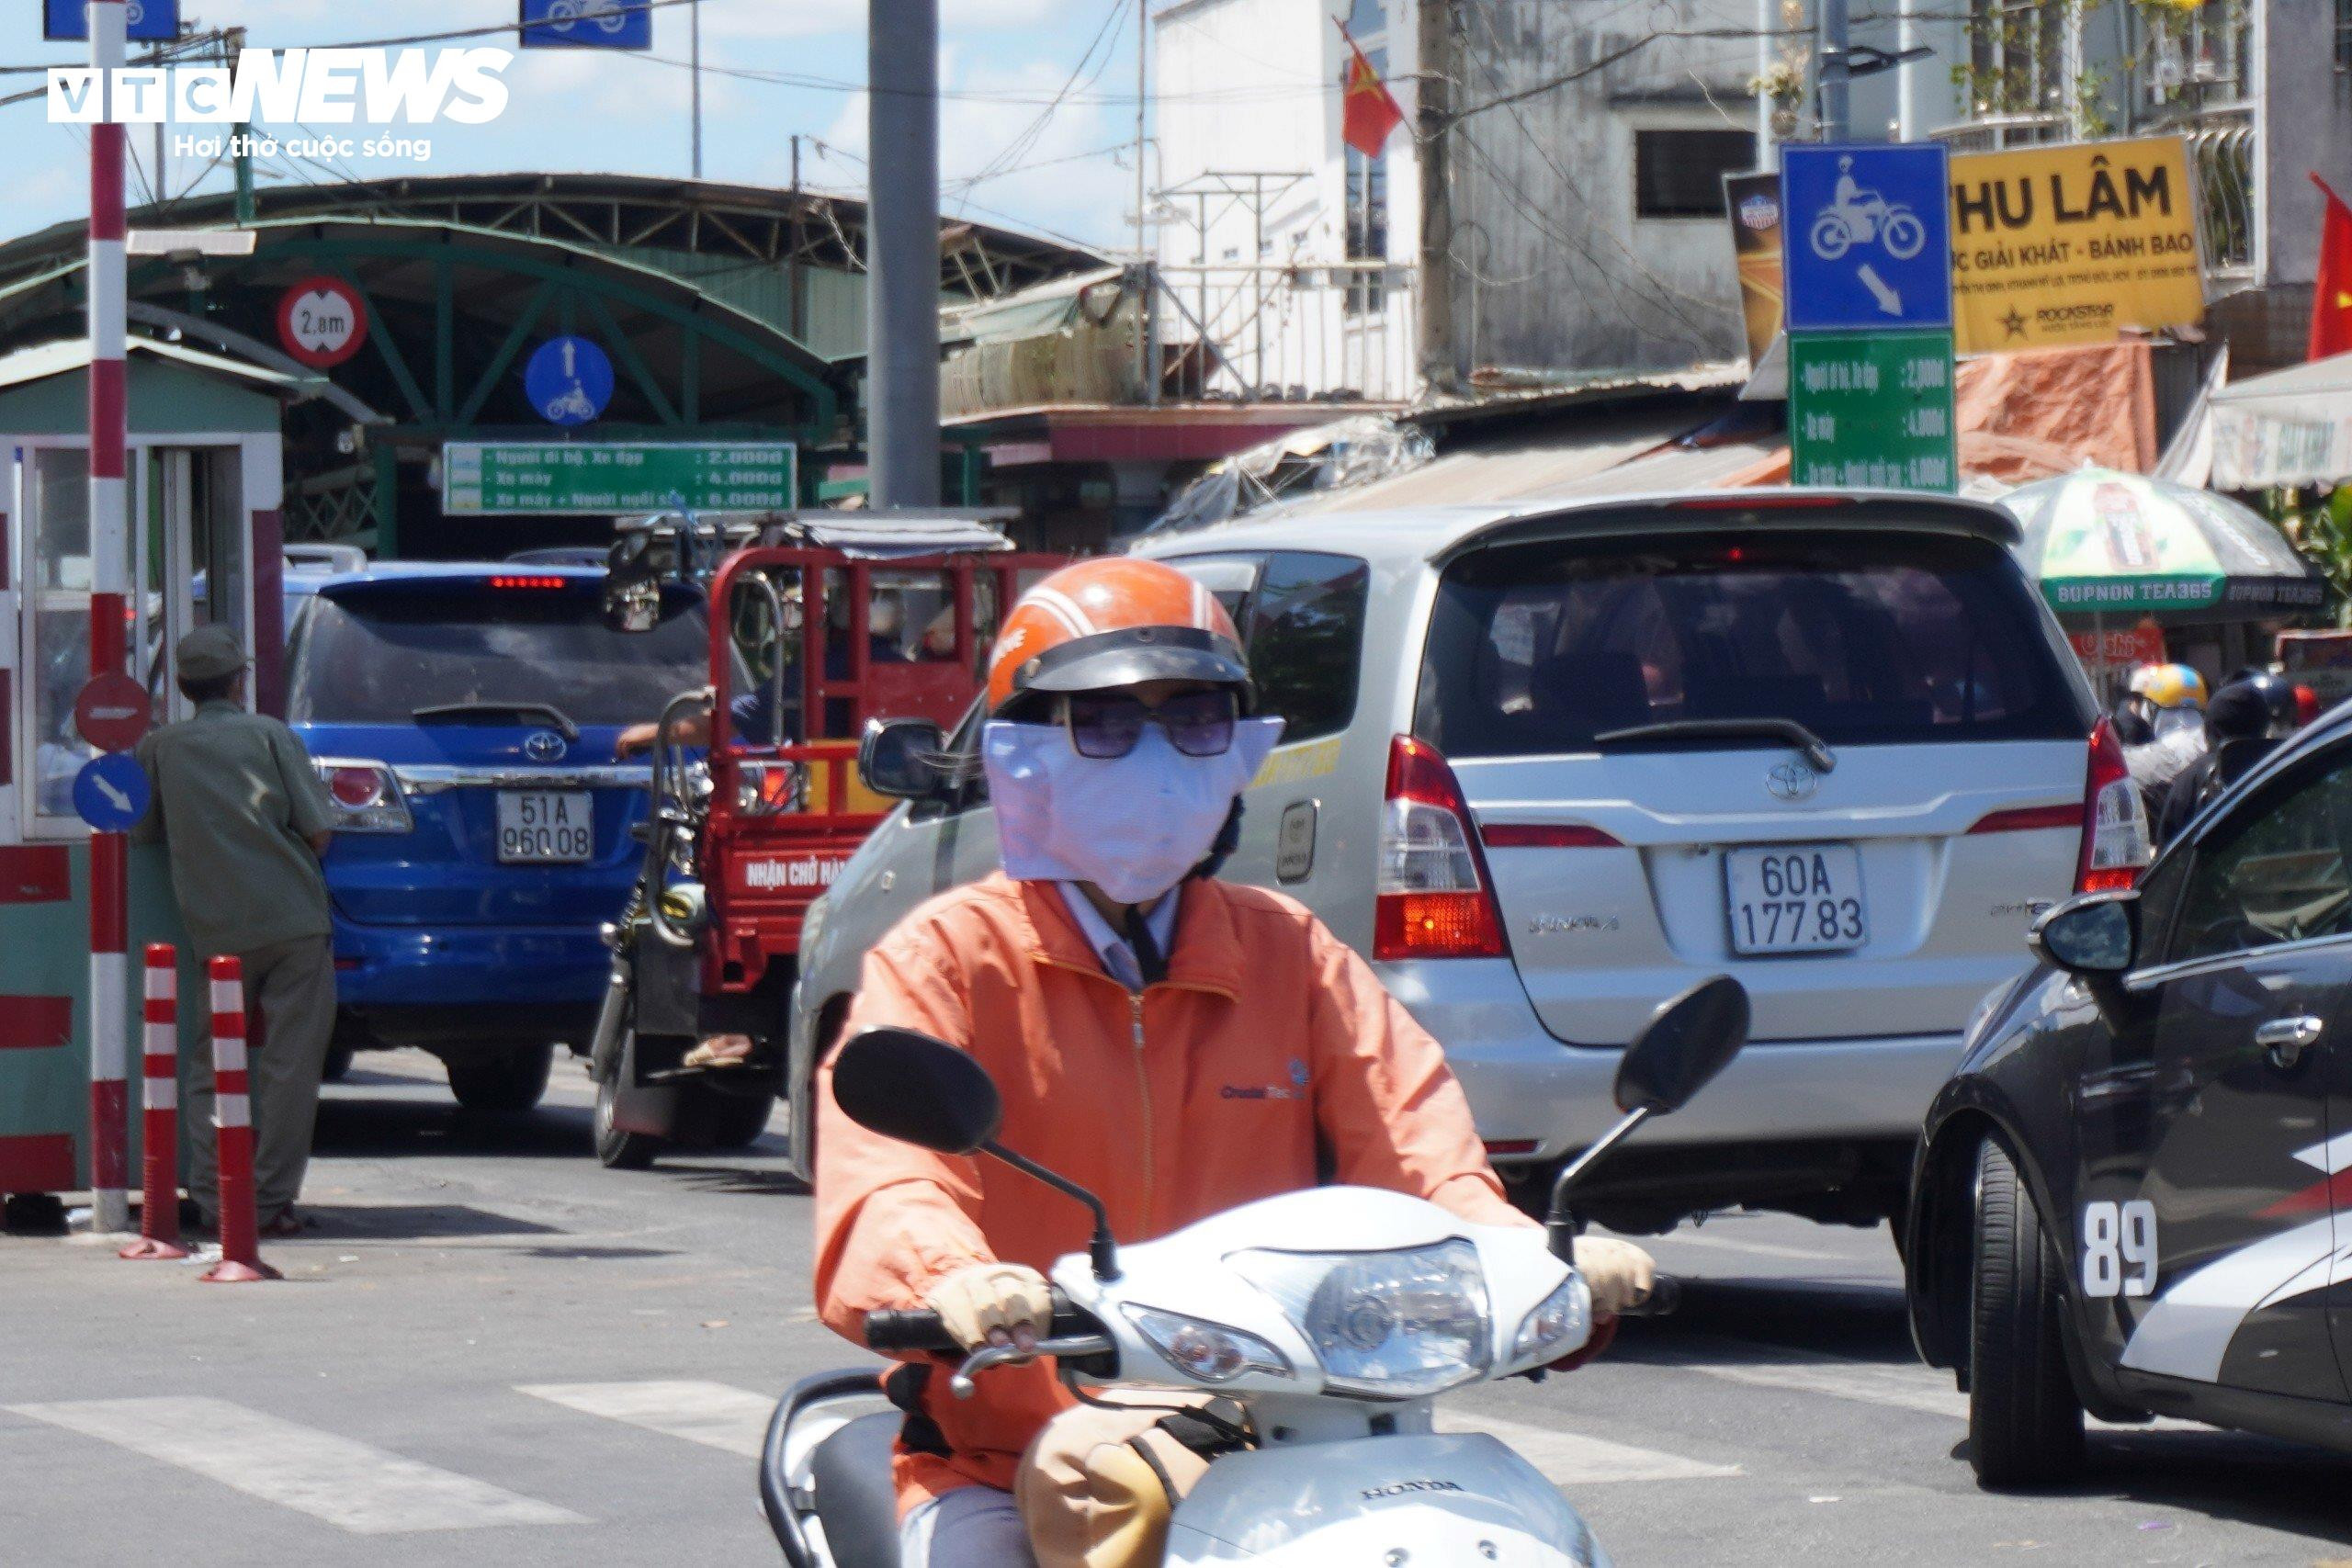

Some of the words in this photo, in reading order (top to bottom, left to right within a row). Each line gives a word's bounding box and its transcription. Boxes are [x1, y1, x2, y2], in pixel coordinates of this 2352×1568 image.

[1950, 177, 2033, 233] HU
[2051, 154, 2172, 223] LÂM
[1975, 241, 2015, 271] GIẢI
[2019, 235, 2070, 266] KHÁT
[2088, 234, 2146, 260] BÁNH
[2151, 232, 2194, 255] BAO
[521, 795, 569, 824] 51A
[746, 858, 786, 891] NHẬN
[789, 852, 817, 886] CHỞ
[820, 856, 846, 886] HÀ
[1761, 852, 1832, 897] 60A
[1742, 897, 1863, 945] 177.83
[2083, 1200, 2158, 1298] 89
[1361, 1480, 1465, 1499] HONDA
